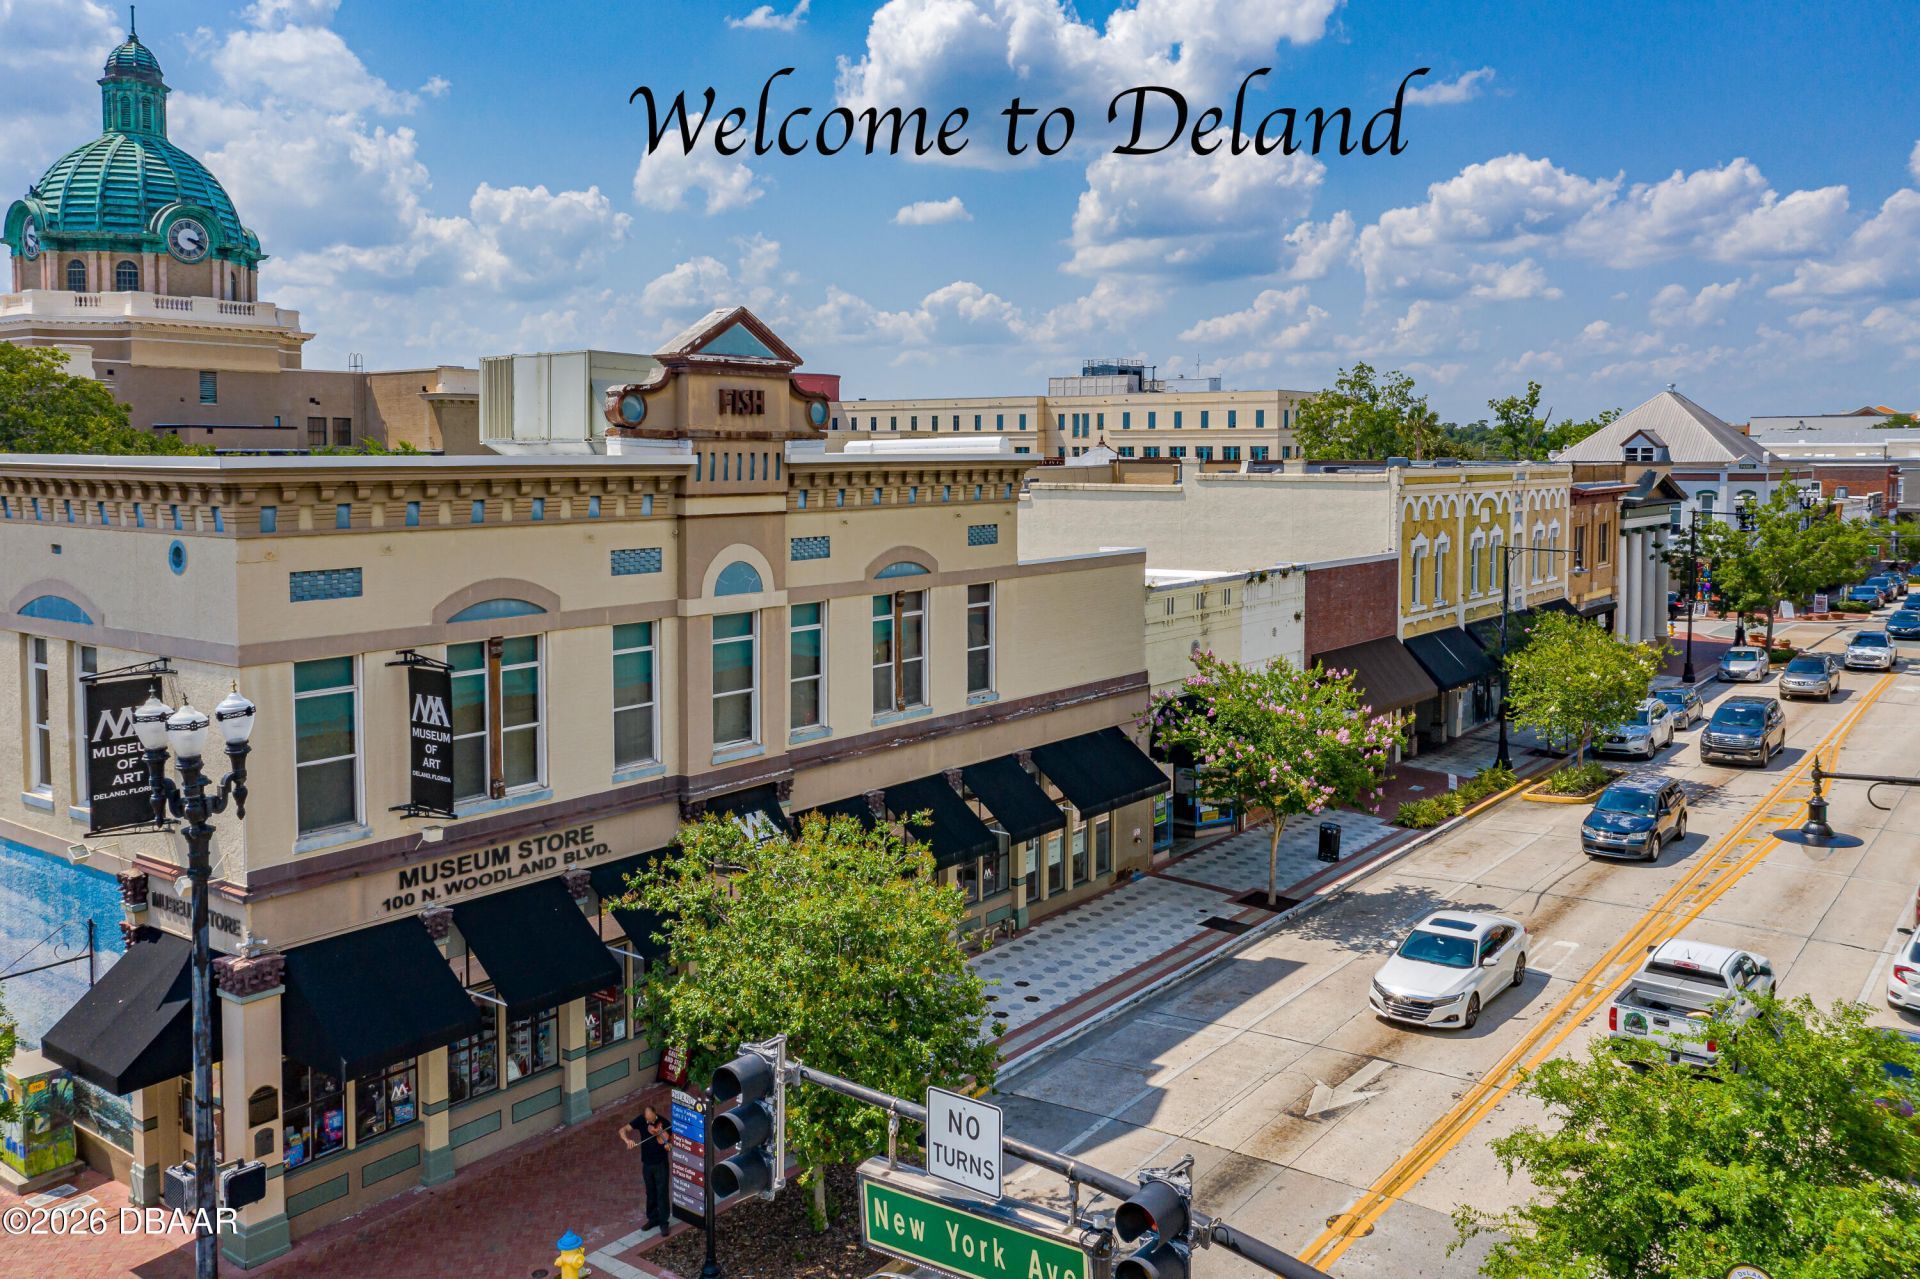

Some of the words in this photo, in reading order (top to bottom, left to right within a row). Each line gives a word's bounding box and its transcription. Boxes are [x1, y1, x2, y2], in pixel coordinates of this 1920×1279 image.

[718, 389, 766, 415] FISH
[412, 727, 451, 743] MUSEUM
[93, 741, 145, 759] MUSEU
[425, 744, 438, 755] OF
[117, 757, 139, 770] OF
[422, 757, 441, 770] ART
[112, 771, 144, 786] ART
[93, 787, 128, 801] DELAND,
[129, 785, 152, 795] FLORI
[398, 848, 511, 891] MUSEUM
[518, 825, 595, 860] STORE
[382, 891, 416, 912] 100
[421, 887, 442, 903] N.
[444, 856, 557, 896] WOODLAND
[563, 843, 612, 865] BLVD.
[152, 890, 192, 919] MUSEU
[207, 909, 241, 937] TORE
[948, 1108, 980, 1141] NO
[933, 1141, 995, 1181] TURNS
[874, 1197, 925, 1242] New
[945, 1220, 1007, 1271] York
